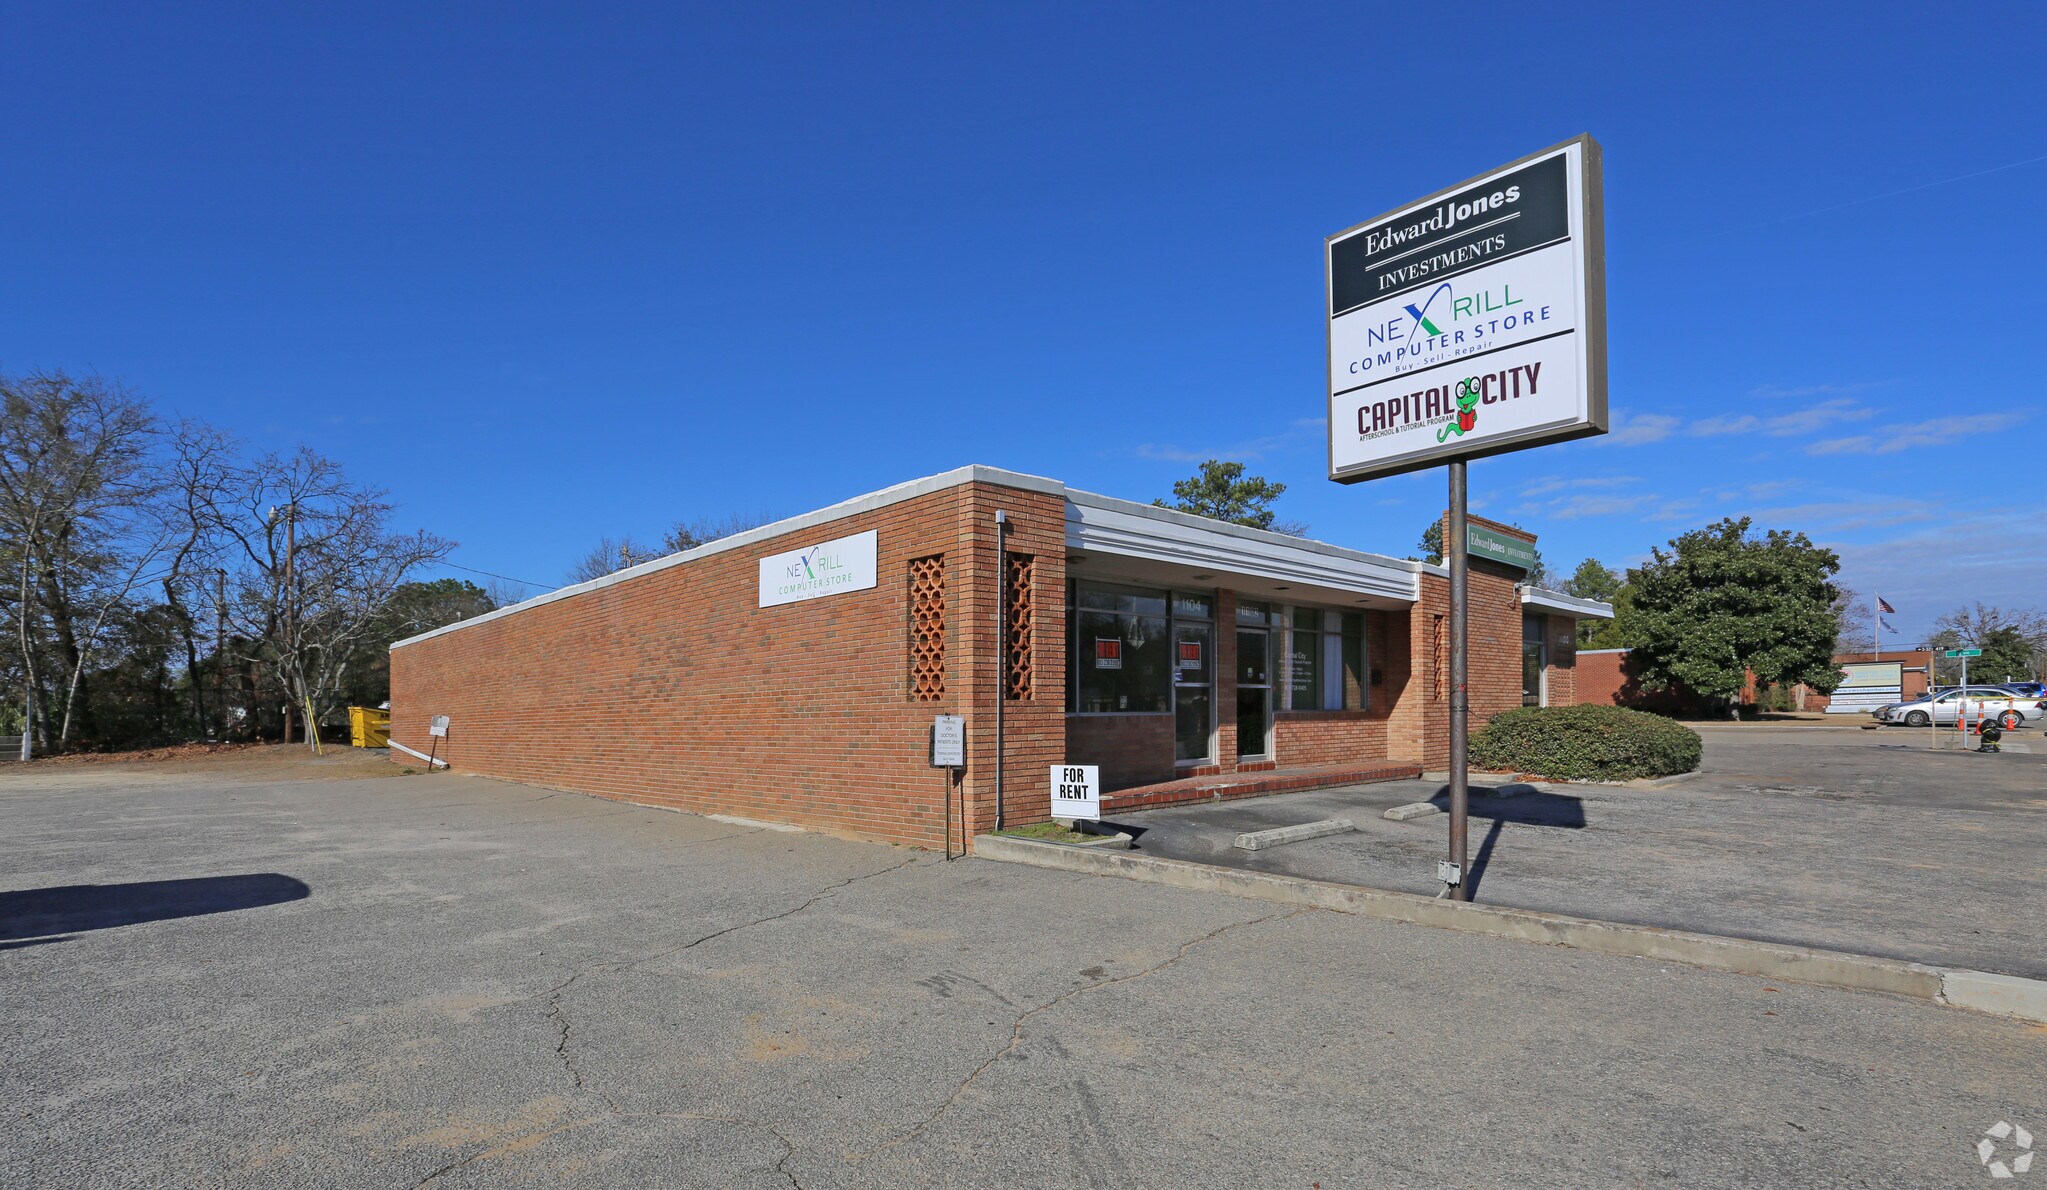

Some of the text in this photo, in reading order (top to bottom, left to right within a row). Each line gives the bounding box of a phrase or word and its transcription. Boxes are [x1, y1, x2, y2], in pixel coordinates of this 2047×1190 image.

[1379, 234, 1506, 290] INVESTMENTS
[1349, 305, 1550, 374] COMPUTER STORE
[1395, 363, 1413, 373] Buy
[1423, 352, 1444, 365] Sell
[1454, 340, 1493, 356] Repair
[1358, 361, 1541, 435] CAPITAL CITY
[1360, 427, 1395, 442] AFTERSCHOOL
[1400, 419, 1426, 432] TUTORIAL
[1427, 413, 1455, 426] PROGRAM
[778, 572, 852, 595] COMPUTER STORE
[1182, 599, 1201, 612] 1104
[1063, 768, 1084, 783] FOR
[1059, 784, 1089, 800] RENT
